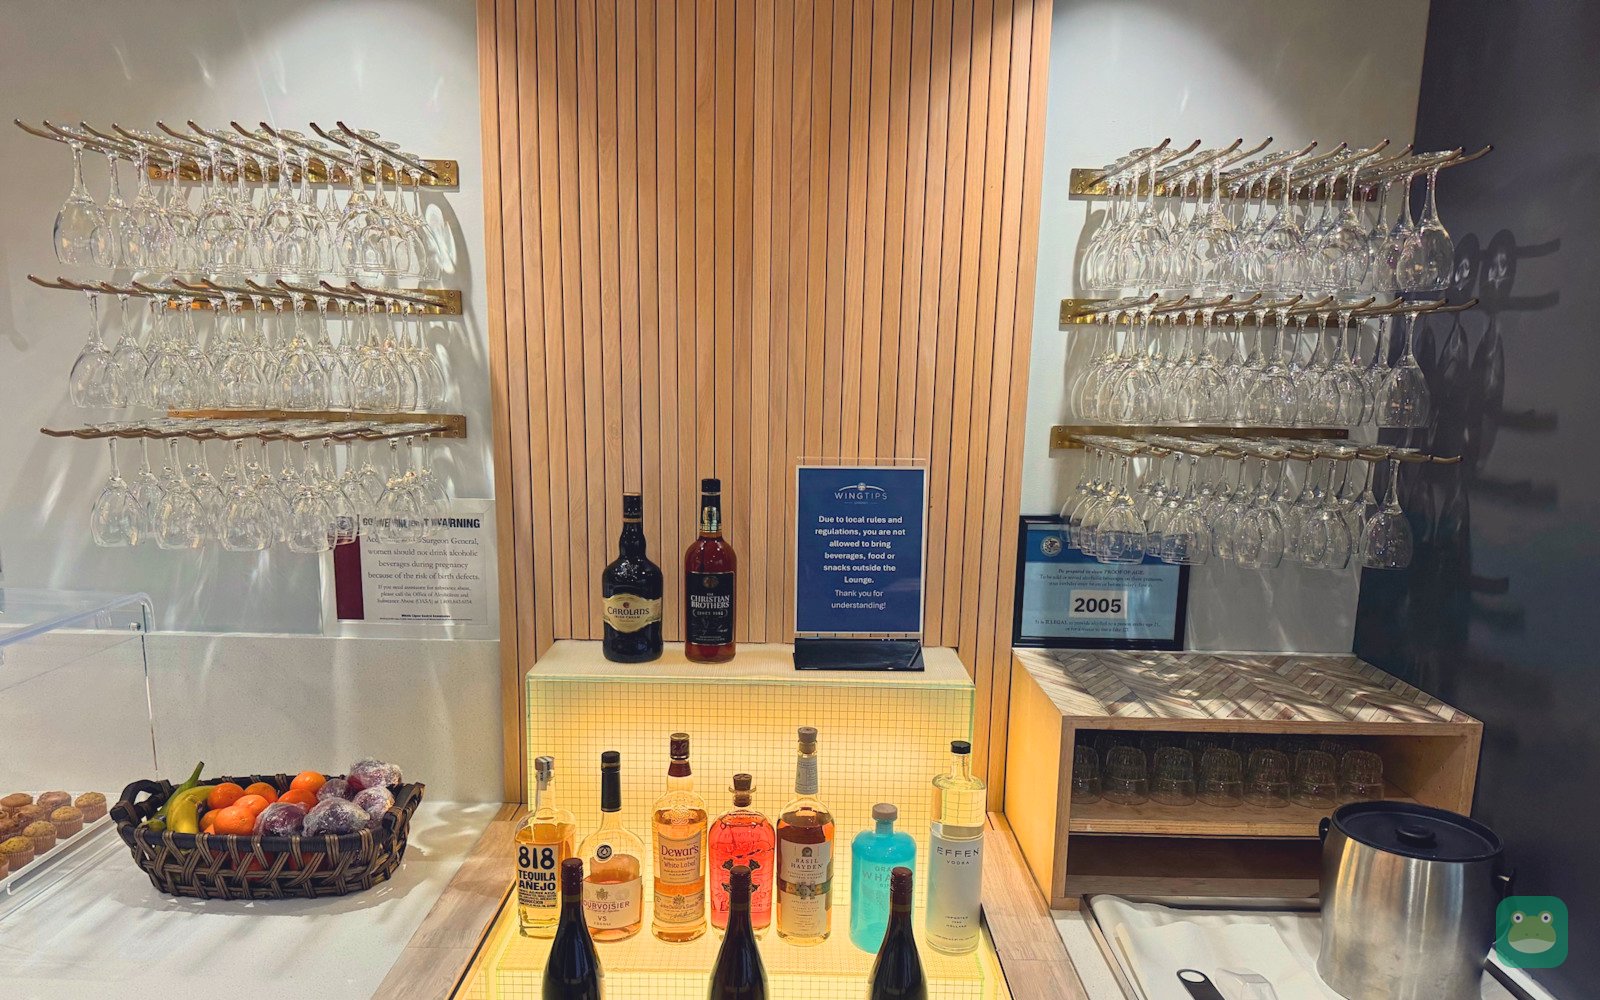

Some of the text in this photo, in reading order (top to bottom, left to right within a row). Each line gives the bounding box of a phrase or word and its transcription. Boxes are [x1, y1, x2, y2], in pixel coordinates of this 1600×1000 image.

[834, 492, 888, 500] WINGTIPS
[818, 515, 834, 523] Due
[845, 515, 865, 523] local
[815, 528, 861, 536] regulations,
[862, 529, 877, 537] you
[892, 528, 906, 536] not
[421, 537, 449, 546] Surgeon
[450, 537, 479, 546] General,
[829, 540, 859, 548] allowed
[871, 540, 891, 549] bring
[393, 548, 415, 556] should
[429, 549, 448, 557] drink
[824, 552, 866, 561] beverages,
[867, 552, 885, 560] food
[378, 560, 410, 568] beverages
[411, 561, 433, 569] during
[883, 564, 896, 572] the
[367, 571, 393, 579] because
[844, 576, 875, 585] Lounge.
[834, 589, 857, 597] Thank
[872, 589, 884, 597] for
[690, 594, 730, 602] CHRISTIAN
[691, 601, 730, 609] BROTHERS
[831, 601, 887, 610] understanding!
[1074, 598, 1122, 613] 2005
[607, 606, 650, 615] CAROLANS
[661, 845, 699, 857] Dewar's
[936, 846, 979, 858] EFFEN
[518, 846, 555, 870] 818
[680, 859, 696, 868] Label
[791, 862, 823, 870] HAYDEN
[518, 869, 556, 881] TEQUILA
[862, 870, 891, 882] WHA
[583, 899, 630, 910] OURVOISIER
